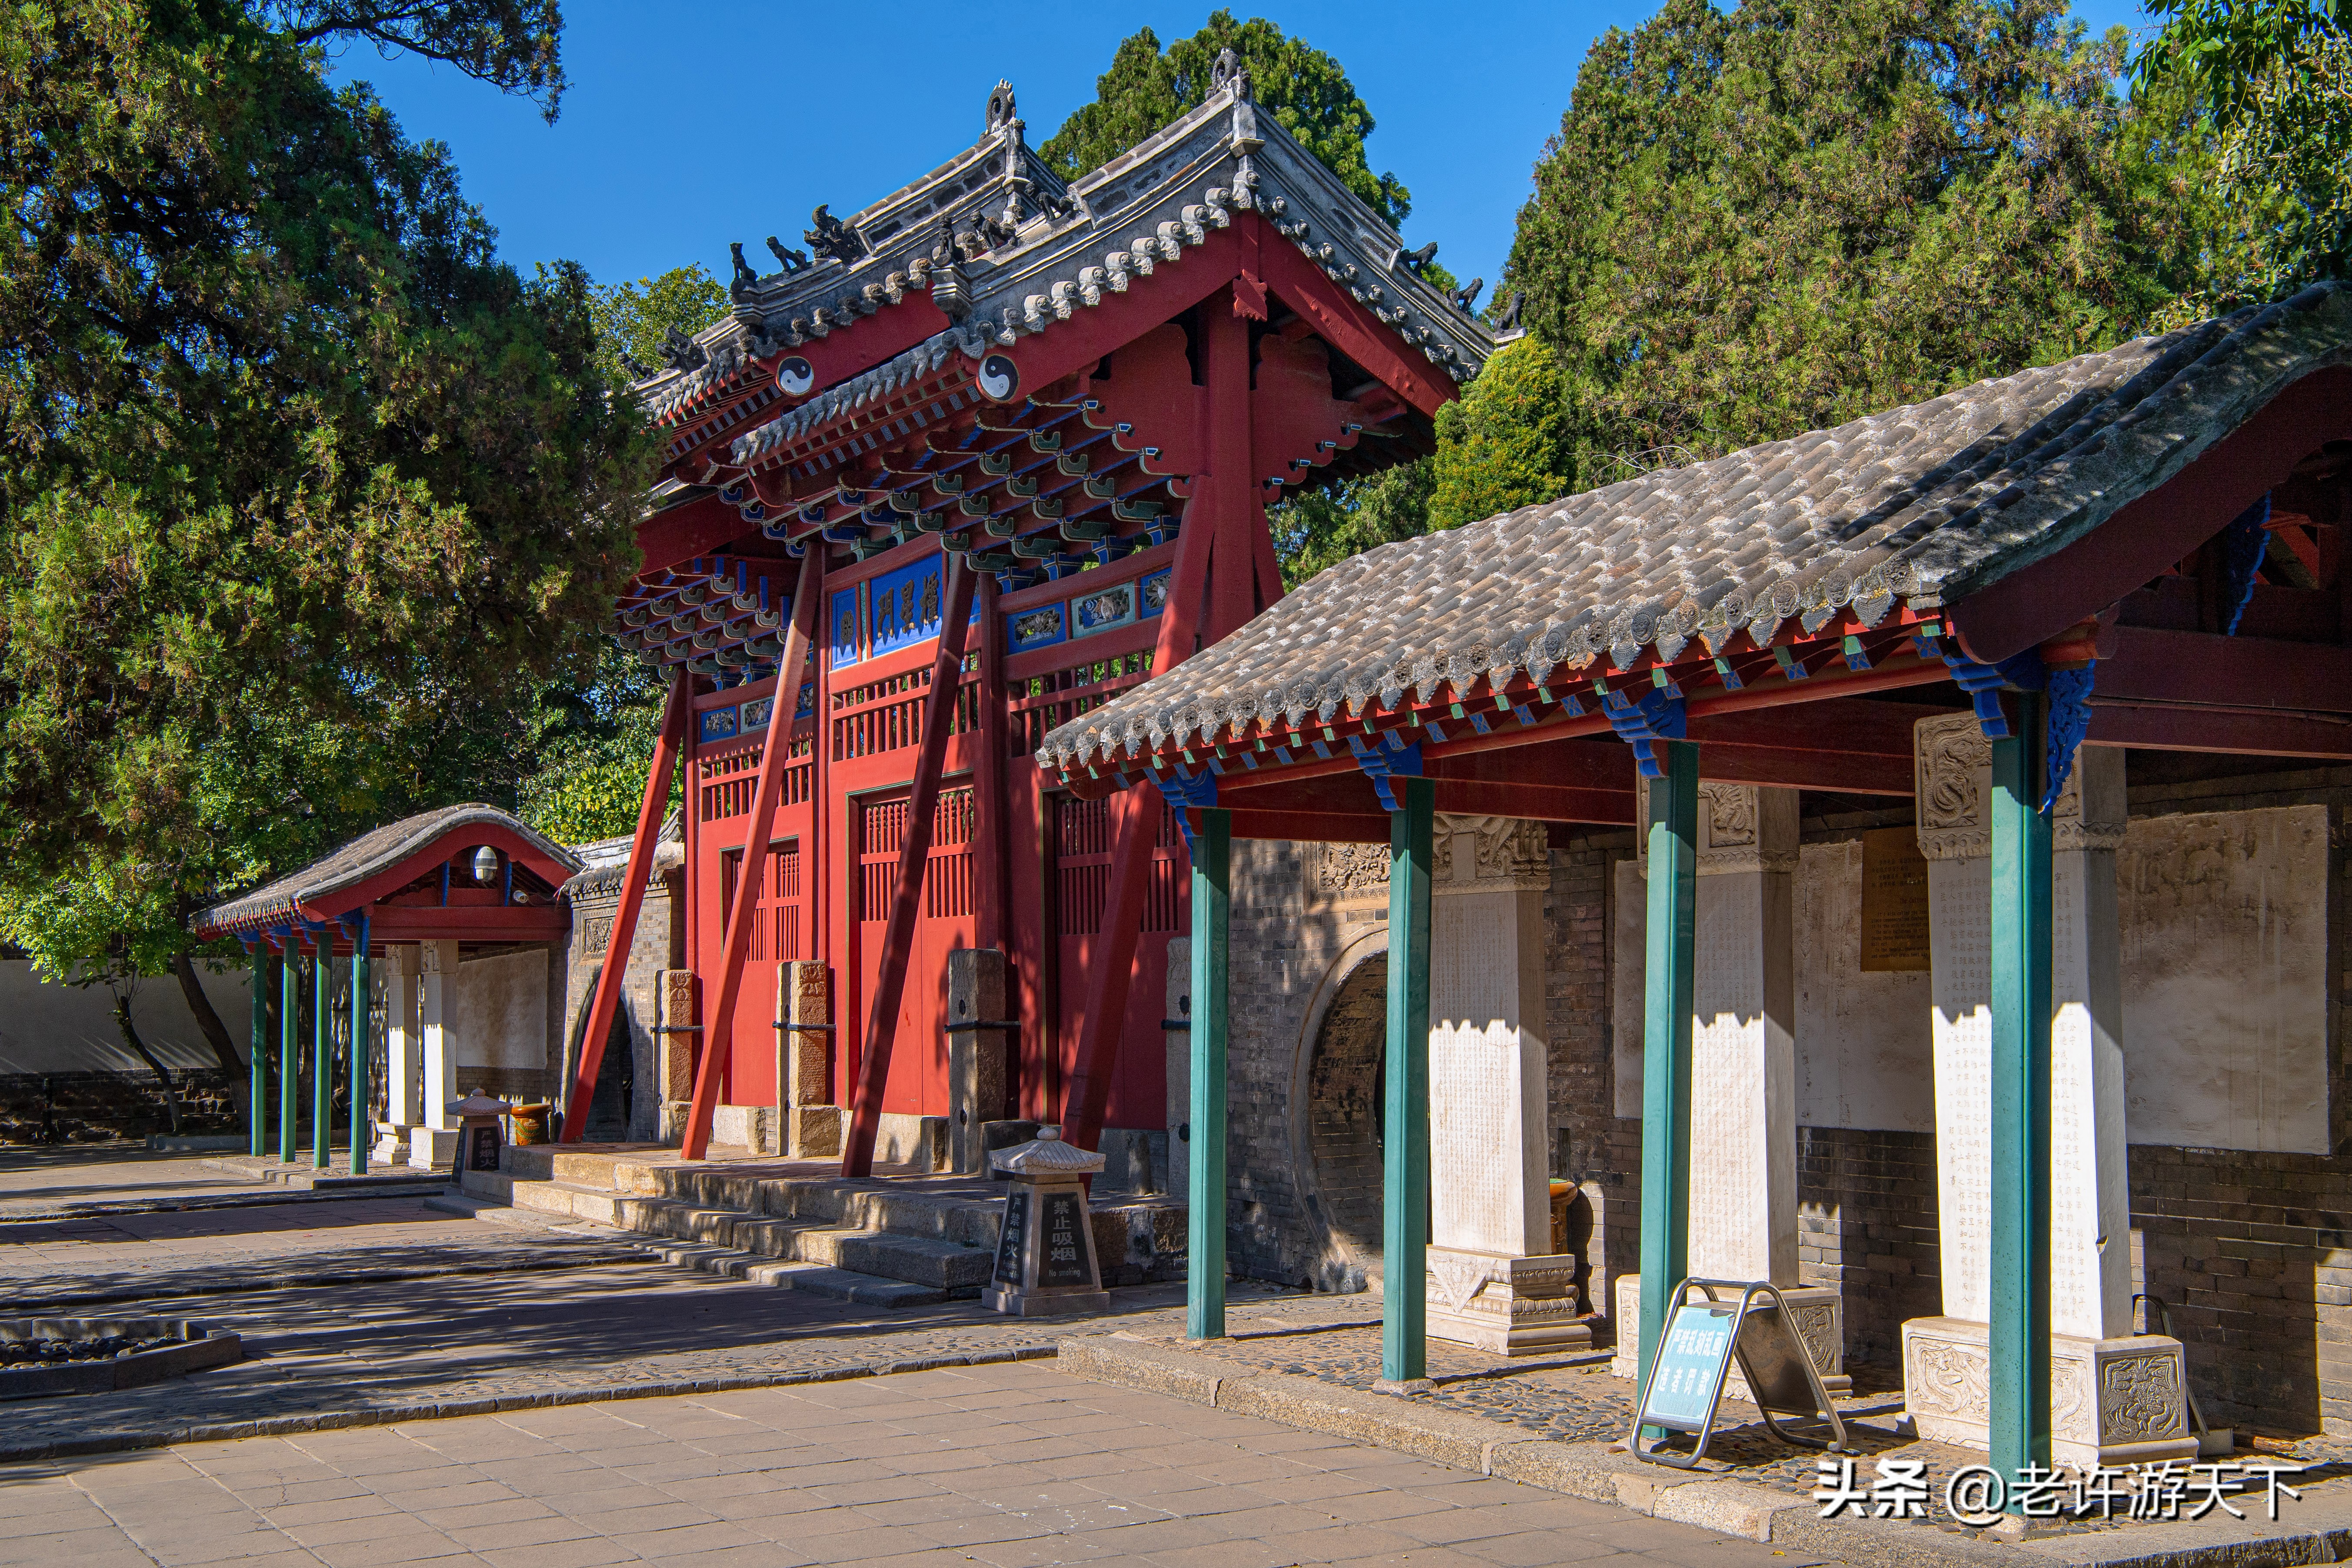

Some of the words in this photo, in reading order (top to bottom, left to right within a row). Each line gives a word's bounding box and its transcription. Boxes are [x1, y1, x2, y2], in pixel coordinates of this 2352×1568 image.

[480, 1130, 496, 1167] 严禁烟火
[1005, 1198, 1021, 1258] 严禁烟火
[1050, 1200, 1076, 1261] 禁止吸烟
[1059, 1267, 1080, 1277] smoking
[1669, 1328, 1725, 1358] 严禁乱刻乱画
